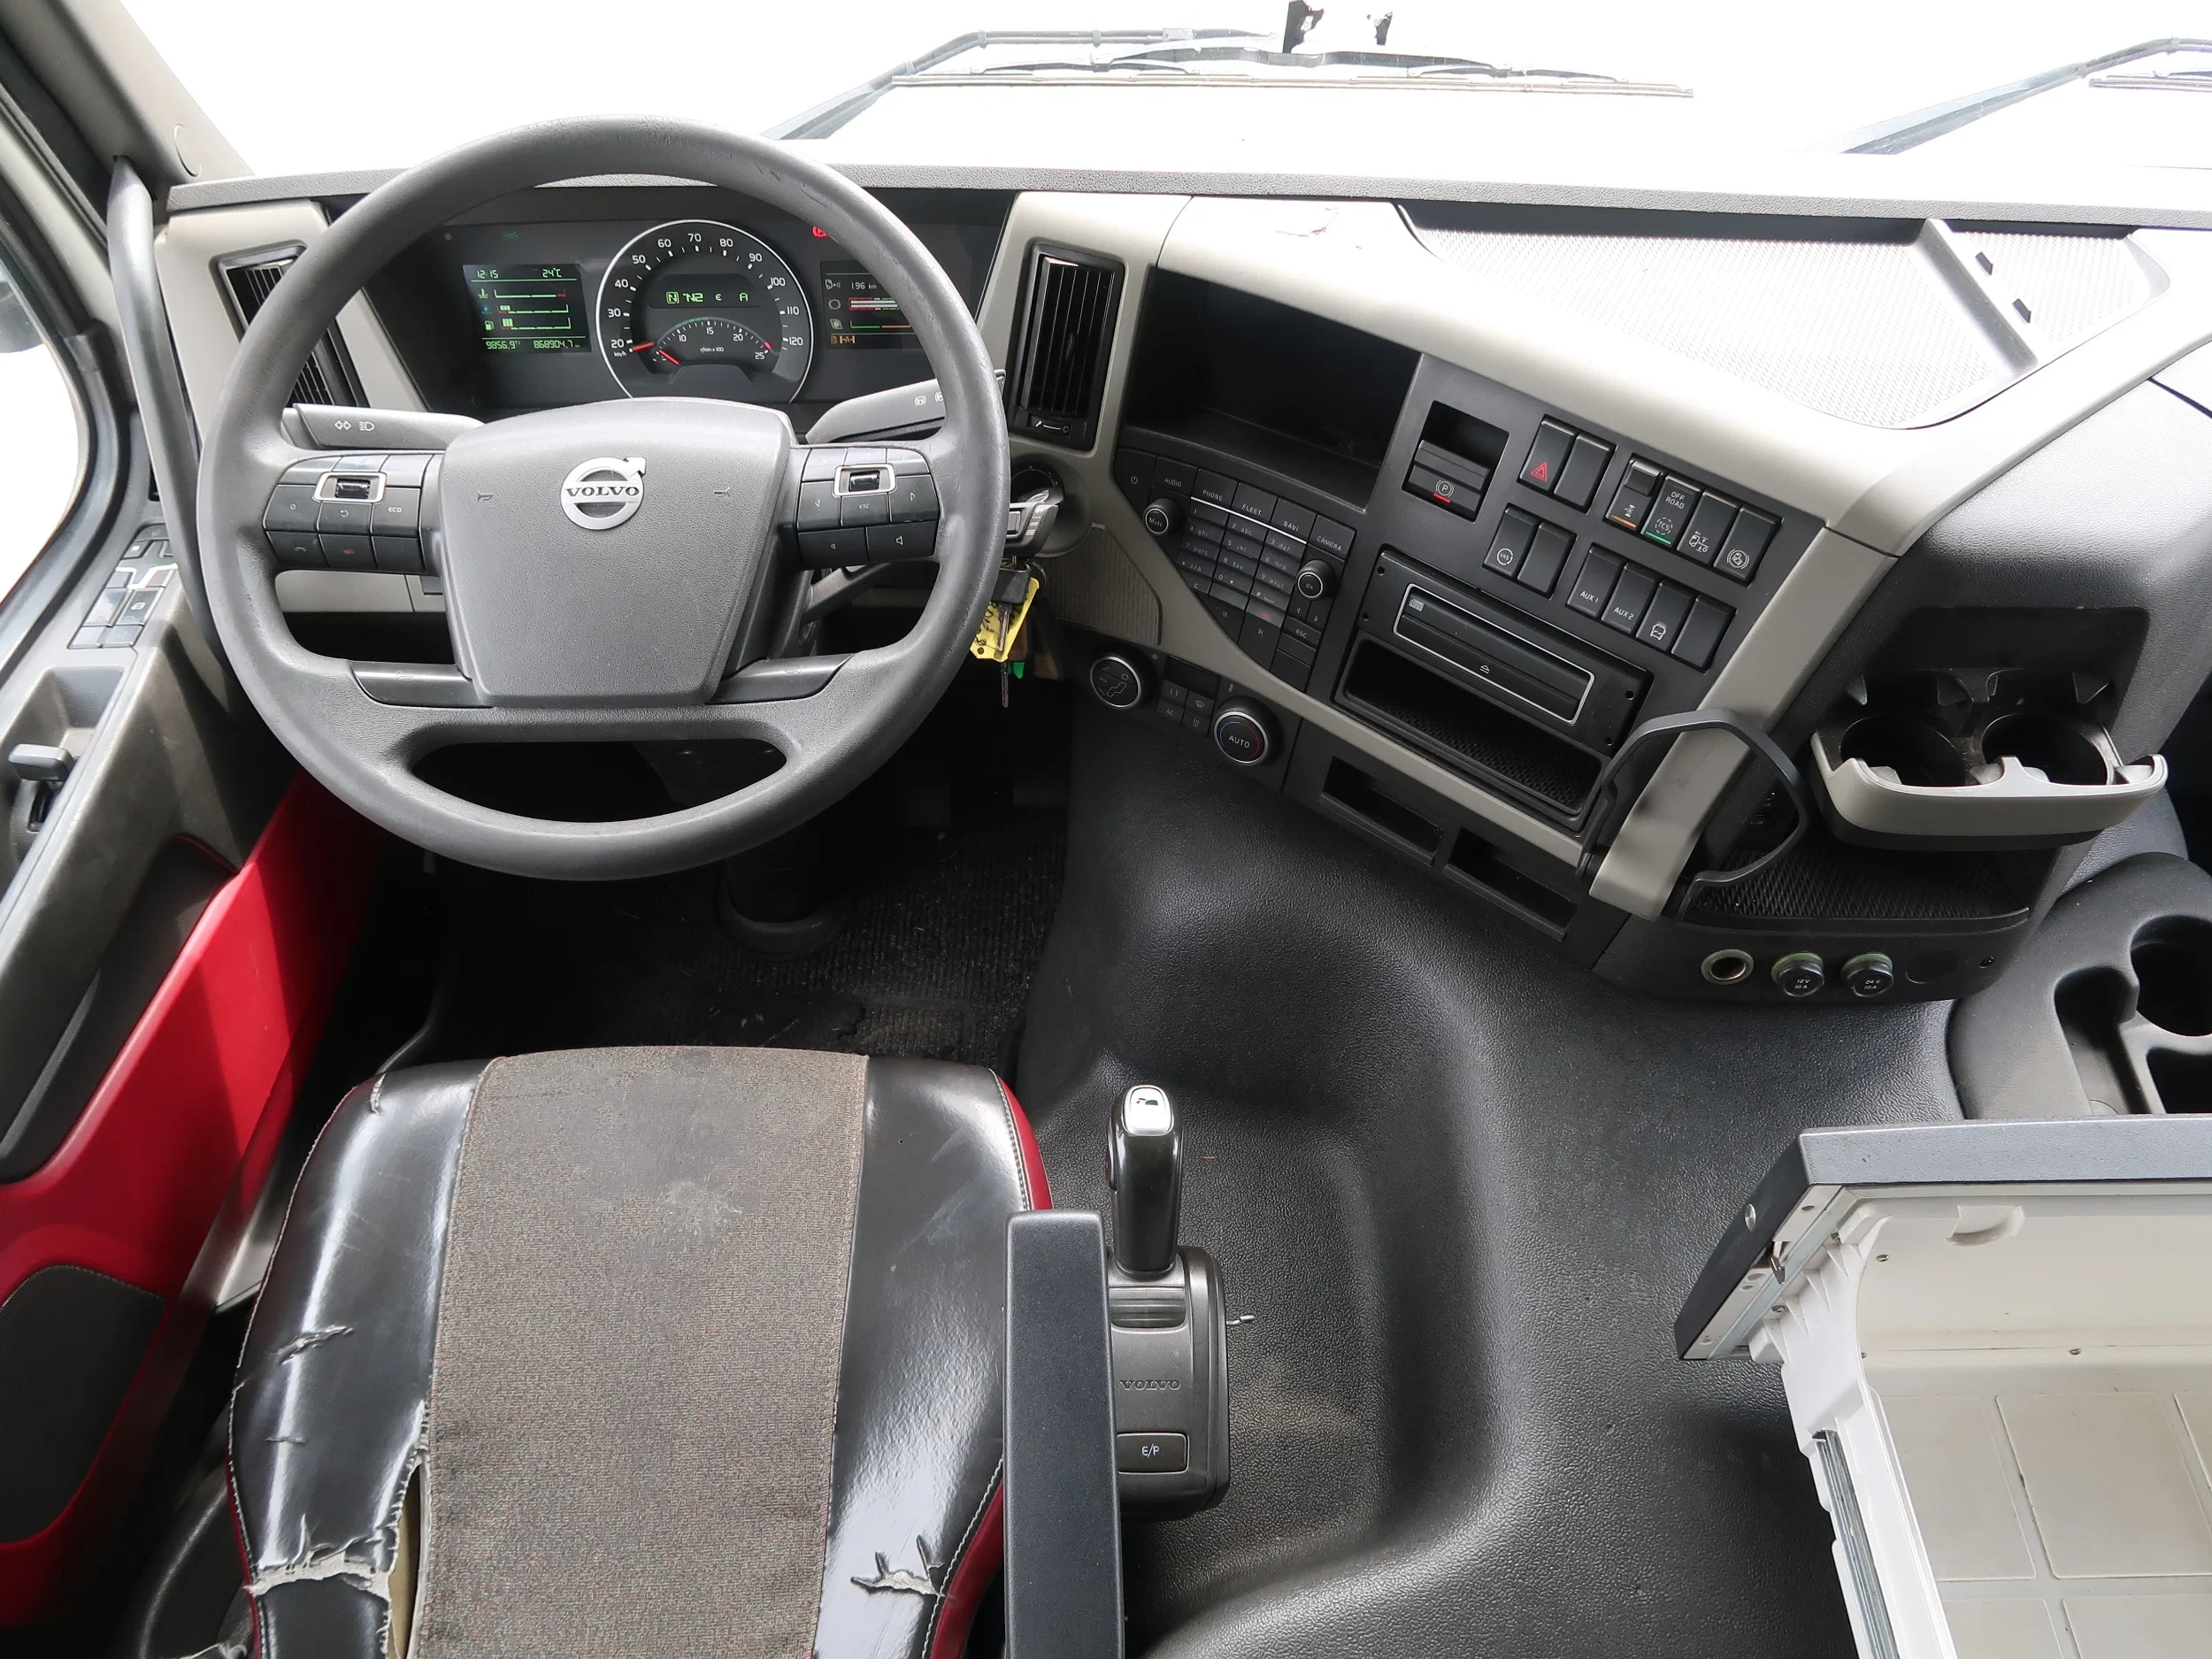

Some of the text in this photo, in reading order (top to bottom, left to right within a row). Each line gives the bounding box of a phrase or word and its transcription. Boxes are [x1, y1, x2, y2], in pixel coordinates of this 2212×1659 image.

[687, 233, 702, 242] 70
[657, 239, 672, 248] 60
[719, 238, 733, 248] 80
[632, 255, 646, 264] 50
[749, 253, 763, 263] 90
[477, 269, 499, 279] 12:15
[614, 279, 629, 288] 40
[770, 277, 786, 287] 100
[739, 292, 749, 302] A
[608, 308, 622, 318] 30
[787, 306, 800, 316] 110
[611, 339, 625, 349] 20
[788, 337, 803, 346] 120
[755, 351, 765, 360] 25
[1164, 477, 1182, 488] AUDIO
[565, 487, 640, 497] VOLVO
[1202, 489, 1224, 502] PHONE
[1671, 491, 1686, 501] OFF
[1665, 496, 1685, 510] ROAD
[1241, 503, 1262, 516] FLEET
[1282, 520, 1300, 532] NAVI
[1658, 521, 1671, 531] TCS
[1317, 535, 1342, 551] CAMERA
[1579, 590, 1595, 602] AUX
[1613, 606, 1629, 618] AUX
[1295, 628, 1308, 639] ESC
[1228, 734, 1250, 749] AUTO
[1119, 1379, 1181, 1391] VOLVO
[1141, 1443, 1160, 1458] E/P
